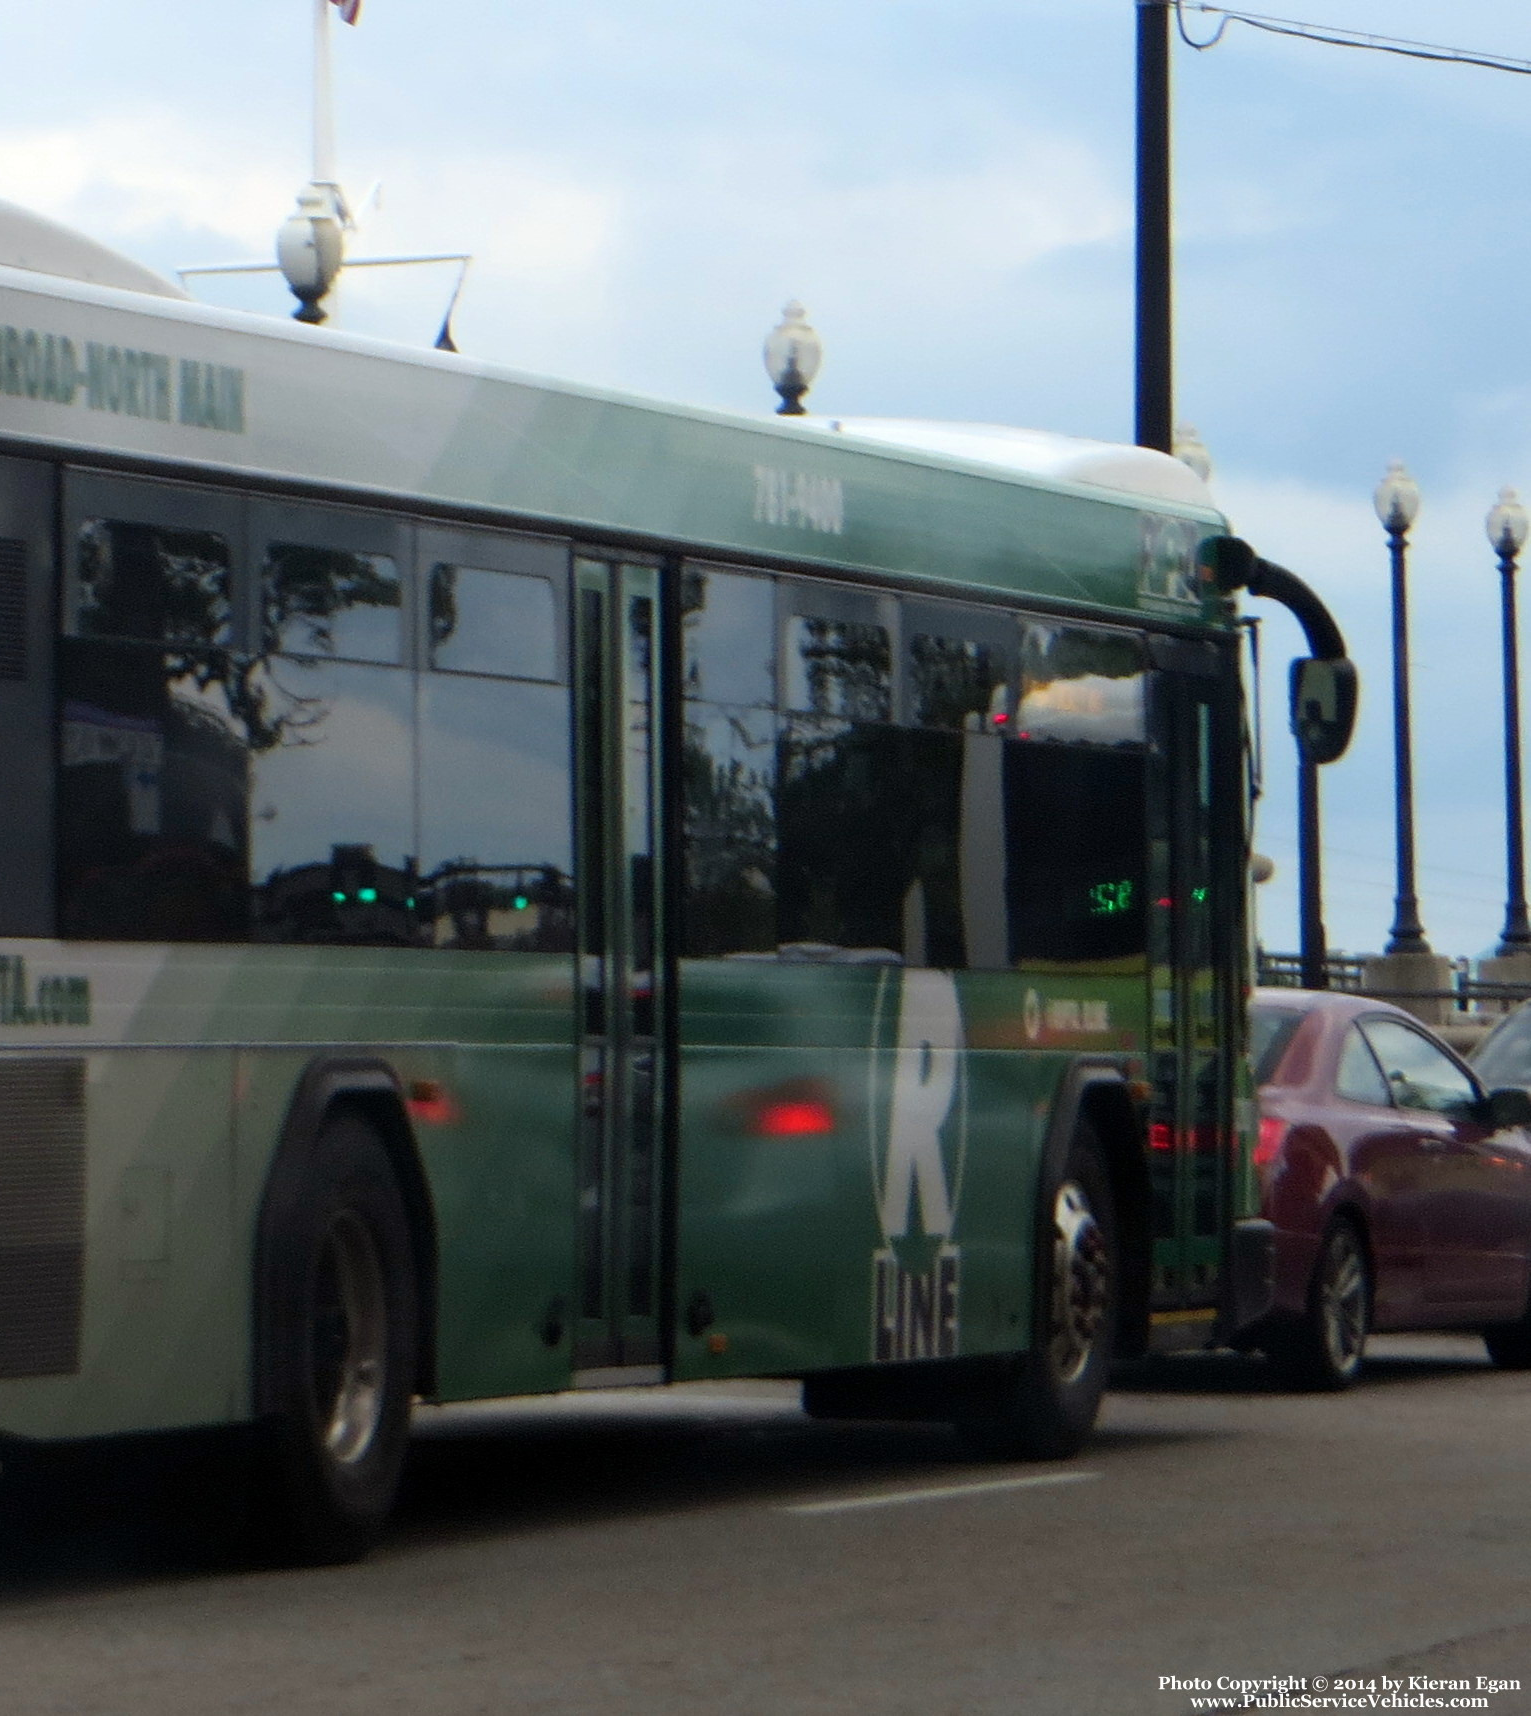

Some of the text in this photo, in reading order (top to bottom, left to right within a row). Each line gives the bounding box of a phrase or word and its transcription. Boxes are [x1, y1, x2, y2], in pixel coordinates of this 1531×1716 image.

[178, 358, 244, 434] MAIN
[882, 970, 964, 1238] R
[874, 1245, 961, 1363] LINE
